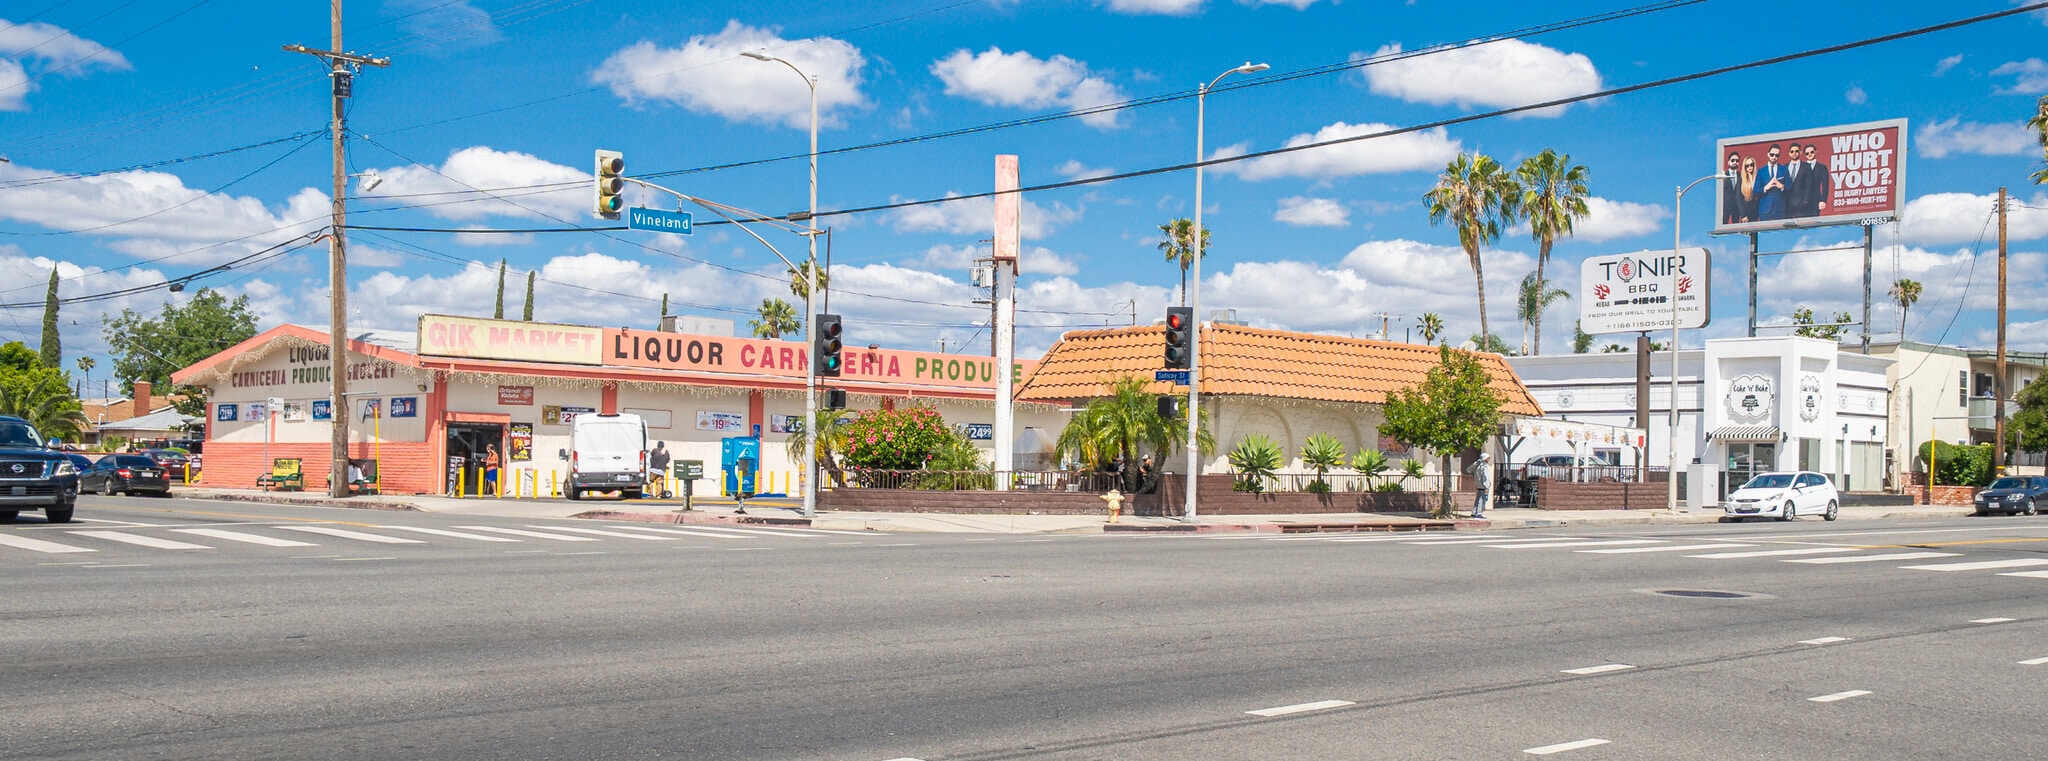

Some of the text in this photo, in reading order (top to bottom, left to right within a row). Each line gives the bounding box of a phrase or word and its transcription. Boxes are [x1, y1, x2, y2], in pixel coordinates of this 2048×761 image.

[1832, 132, 1885, 153] WHO
[1831, 149, 1892, 171] HURT
[1844, 189, 1861, 197] INJURY
[1863, 187, 1887, 196] LAWYERS
[634, 213, 689, 230] Vineland
[1599, 256, 1686, 283] TONIR
[1629, 284, 1657, 293] BBQ
[429, 322, 476, 349] QIK
[489, 327, 596, 357] MARKET
[290, 345, 329, 366] LIQUOR
[615, 335, 1023, 383] LIQUOR CARNERIA PRODUE
[232, 369, 286, 387] CARNICERIA
